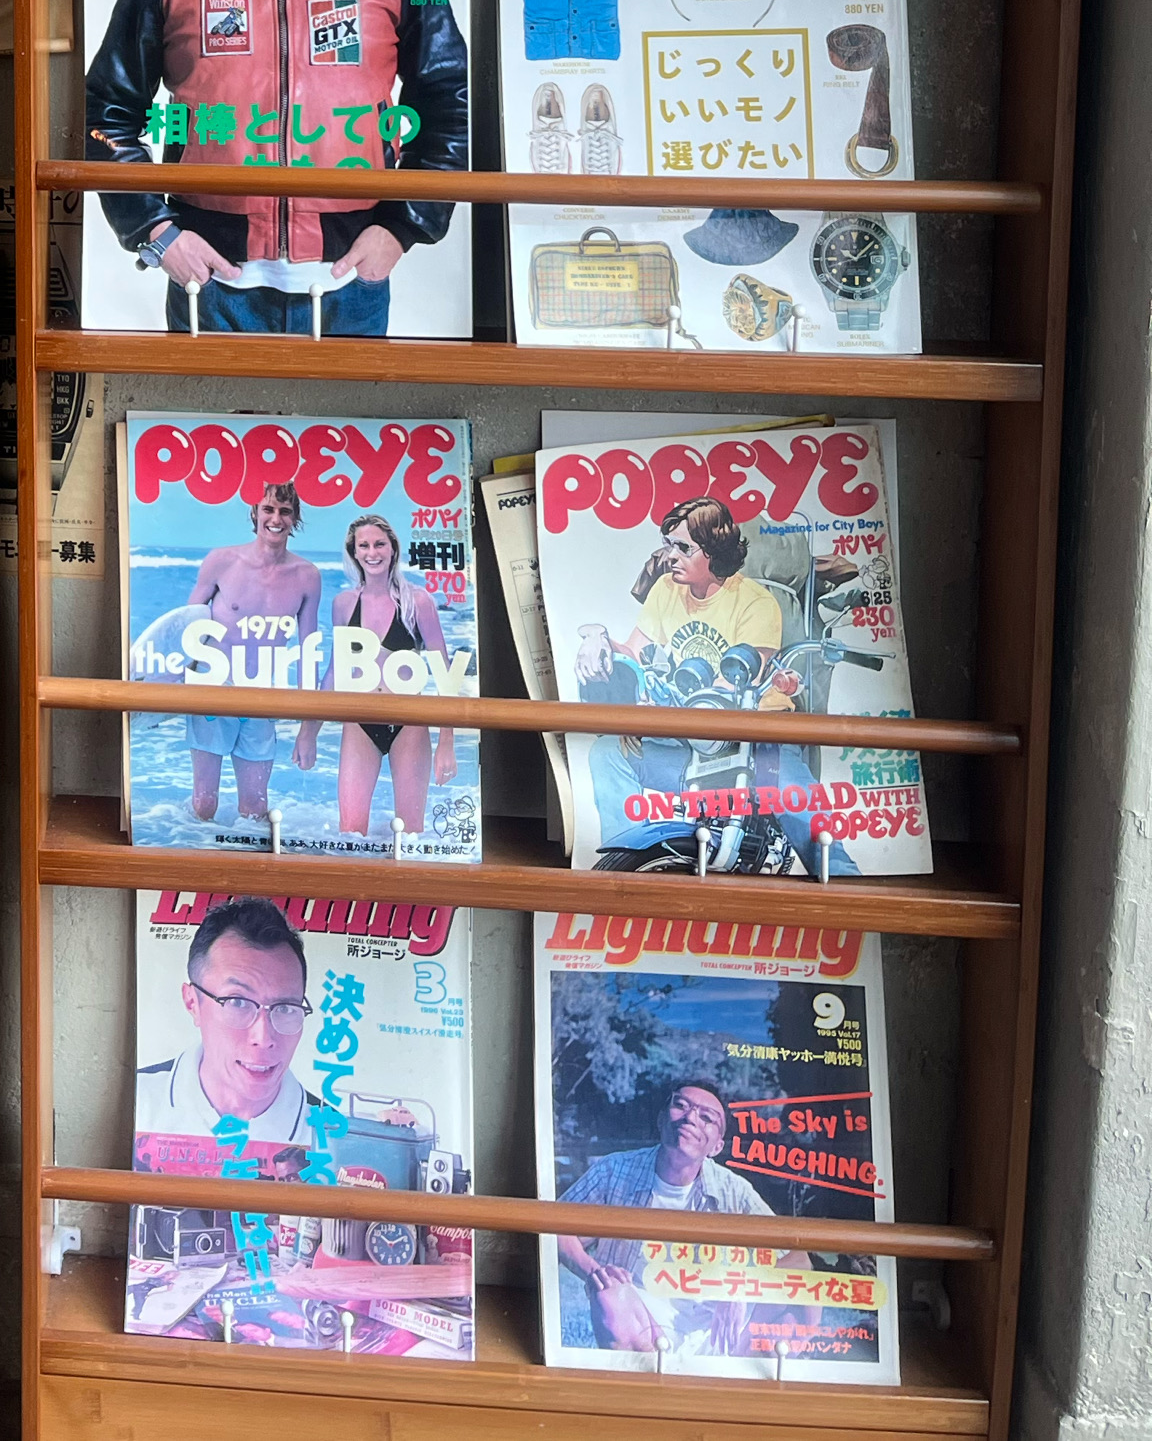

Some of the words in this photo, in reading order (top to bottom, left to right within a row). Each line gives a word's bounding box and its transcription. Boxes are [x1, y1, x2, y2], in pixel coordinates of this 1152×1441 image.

[312, 5, 357, 28] Castrol
[844, 4, 863, 15] 880
[864, 3, 884, 14] YEN
[208, 37, 224, 47] PRO
[225, 36, 247, 46] SERIES
[314, 19, 358, 45] GTX
[314, 39, 344, 53] MOTOR
[345, 36, 359, 45] OIL
[656, 47, 797, 81] じっくり
[146, 102, 421, 146] 相棒としての
[658, 95, 799, 125] いいモノ
[660, 138, 805, 172] 選びたい
[134, 423, 462, 509] POPEYE
[541, 431, 879, 535] POPEYE
[411, 508, 463, 529] ポパイ
[759, 521, 813, 536] Magazine
[814, 519, 830, 533] for
[832, 518, 855, 534] City
[857, 517, 885, 533] Boys
[408, 541, 466, 571] 増刊
[831, 532, 888, 557] ポパイ
[425, 571, 467, 594] 370
[235, 615, 297, 641] 1979
[851, 606, 895, 627] 230
[870, 627, 897, 643] yen
[134, 640, 185, 676] the
[180, 618, 324, 690] Surf
[850, 758, 920, 787] 旅行術
[623, 791, 681, 823] ON
[682, 787, 752, 821] THE
[751, 781, 858, 816] ROAD
[858, 787, 921, 807] WITH
[809, 806, 926, 844] POPEYE
[346, 943, 406, 962] 所ジョージ
[413, 959, 447, 1005] 3
[753, 961, 817, 979] 所ジョージ
[441, 1015, 465, 1028] ¥500
[812, 991, 846, 1030] 9
[837, 1038, 862, 1051] ¥500
[732, 1110, 782, 1137] The
[787, 1109, 839, 1140] Sky
[844, 1109, 870, 1134] is
[730, 1137, 887, 1187] LAUGHING.
[652, 1266, 877, 1308] ヘビーデューティな夏
[375, 1298, 408, 1319] SOLID
[413, 1311, 455, 1334] MODEL
